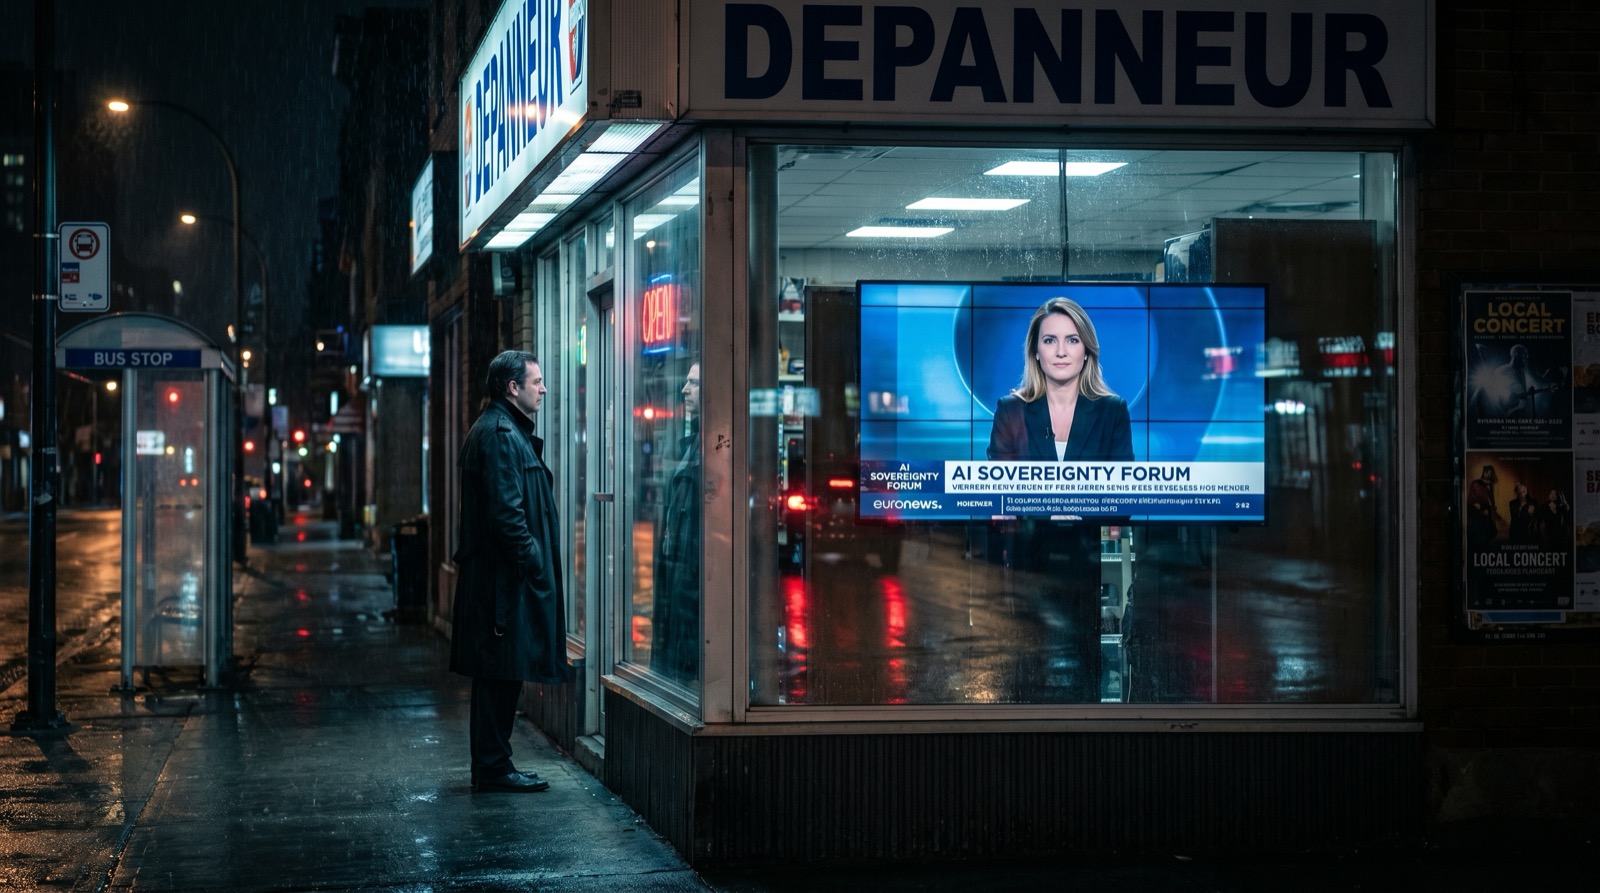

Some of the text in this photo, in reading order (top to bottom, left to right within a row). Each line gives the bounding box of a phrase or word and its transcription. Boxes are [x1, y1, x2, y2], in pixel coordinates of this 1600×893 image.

[724, 3, 1393, 109] DEPANNEUR
[642, 284, 673, 343] OPEN
[1488, 302, 1552, 317] LOCAL
[1473, 318, 1566, 334] CONCERT
[94, 352, 173, 366] BUS STOP
[900, 463, 910, 471] AI
[952, 466, 1191, 482] AI SOVEREIGNTY FORUM
[870, 472, 940, 481] SOVEREIGNTY
[887, 482, 922, 490] FORUM
[1473, 552, 1568, 567] LOCAL CONCERT
